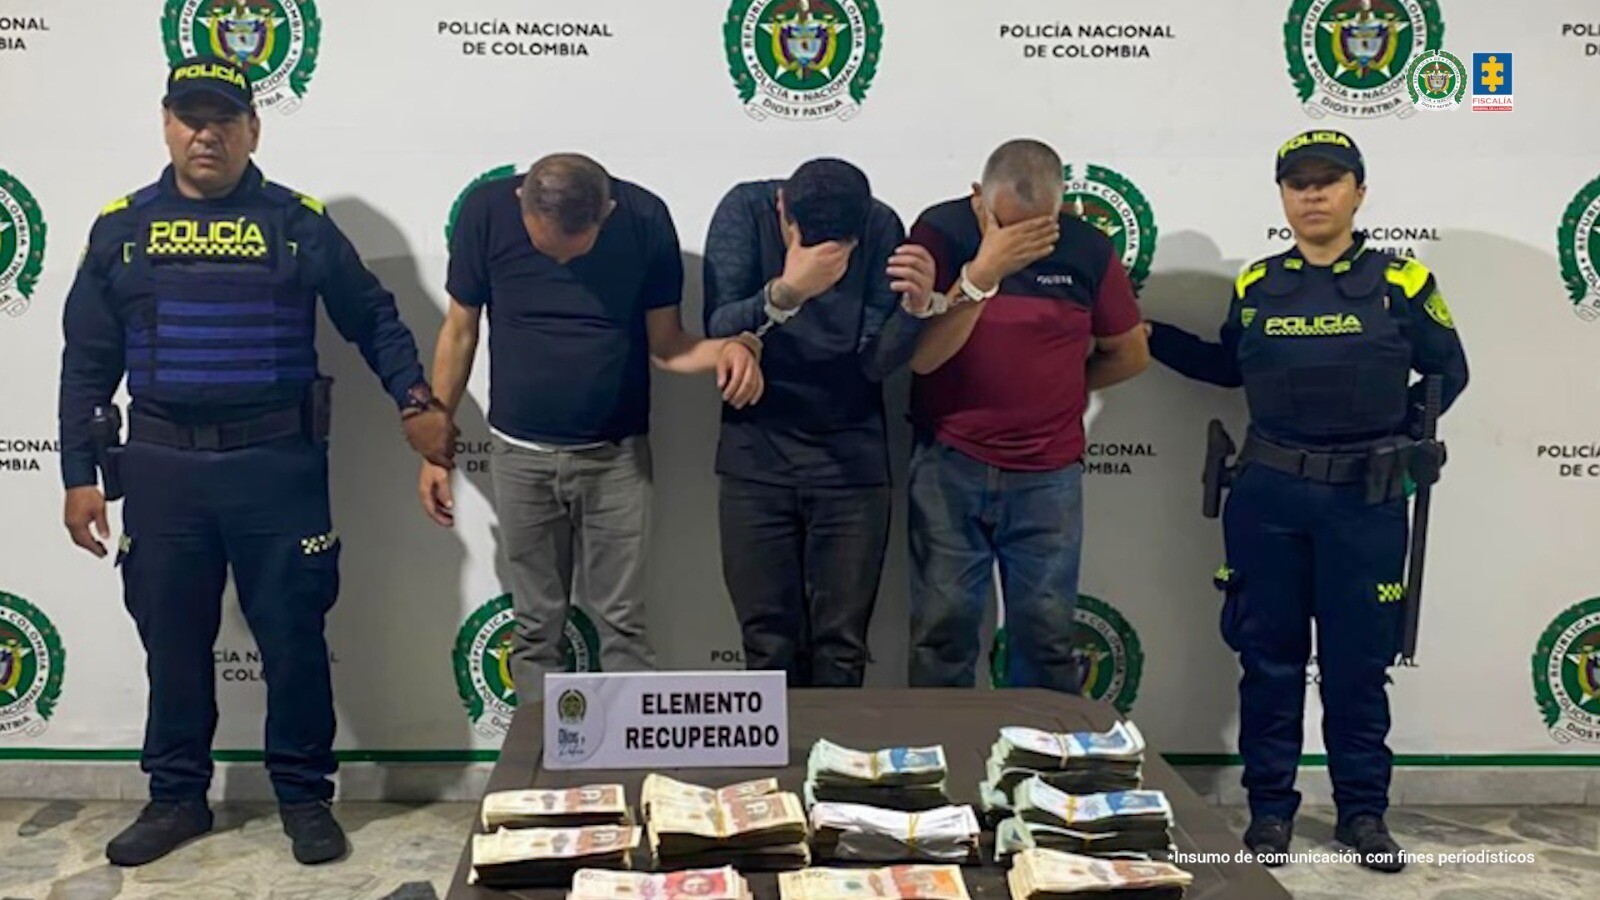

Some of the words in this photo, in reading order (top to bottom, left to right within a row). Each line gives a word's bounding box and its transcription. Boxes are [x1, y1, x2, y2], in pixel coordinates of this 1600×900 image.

[0, 17, 50, 31] ONAL
[285, 0, 301, 42] OMBIA
[437, 19, 511, 36] POLICÍA
[515, 22, 613, 37] NACIONAL
[999, 21, 1073, 39] POLICÍA
[1077, 25, 1176, 39] NACIONAL
[462, 41, 487, 56] DE
[491, 42, 590, 57] COLOMBIA
[1023, 44, 1048, 58] DE
[1052, 44, 1151, 58] COLOMBIA
[252, 57, 297, 93] ACIONAL
[803, 64, 857, 101] NACIONAL
[1362, 70, 1407, 100] NACION
[257, 92, 284, 108] TRIA
[762, 98, 790, 116] DIOS
[802, 99, 843, 117] PATRIA
[1321, 96, 1349, 115] DIOS
[1360, 98, 1403, 115] PATRIA
[0, 190, 28, 247] OLOMBIA
[1072, 182, 1089, 190] DE
[1101, 189, 1137, 251] COLOMBIA
[150, 216, 266, 245] POLICÍA
[1363, 227, 1441, 241] ACIONAL
[0, 440, 62, 452] CIONAL
[1087, 443, 1158, 456] CIONAL
[0, 458, 41, 471] MBIA
[467, 460, 490, 473] DE
[1560, 464, 1583, 477] DE
[8, 612, 46, 671] COLOMBIA
[473, 612, 511, 673] REPUBLICA
[1551, 618, 1593, 678] REPUBLICA
[641, 691, 763, 715] ELEMENTO
[0, 715, 31, 731] ATRIA
[626, 724, 780, 749] RECUPERADO
